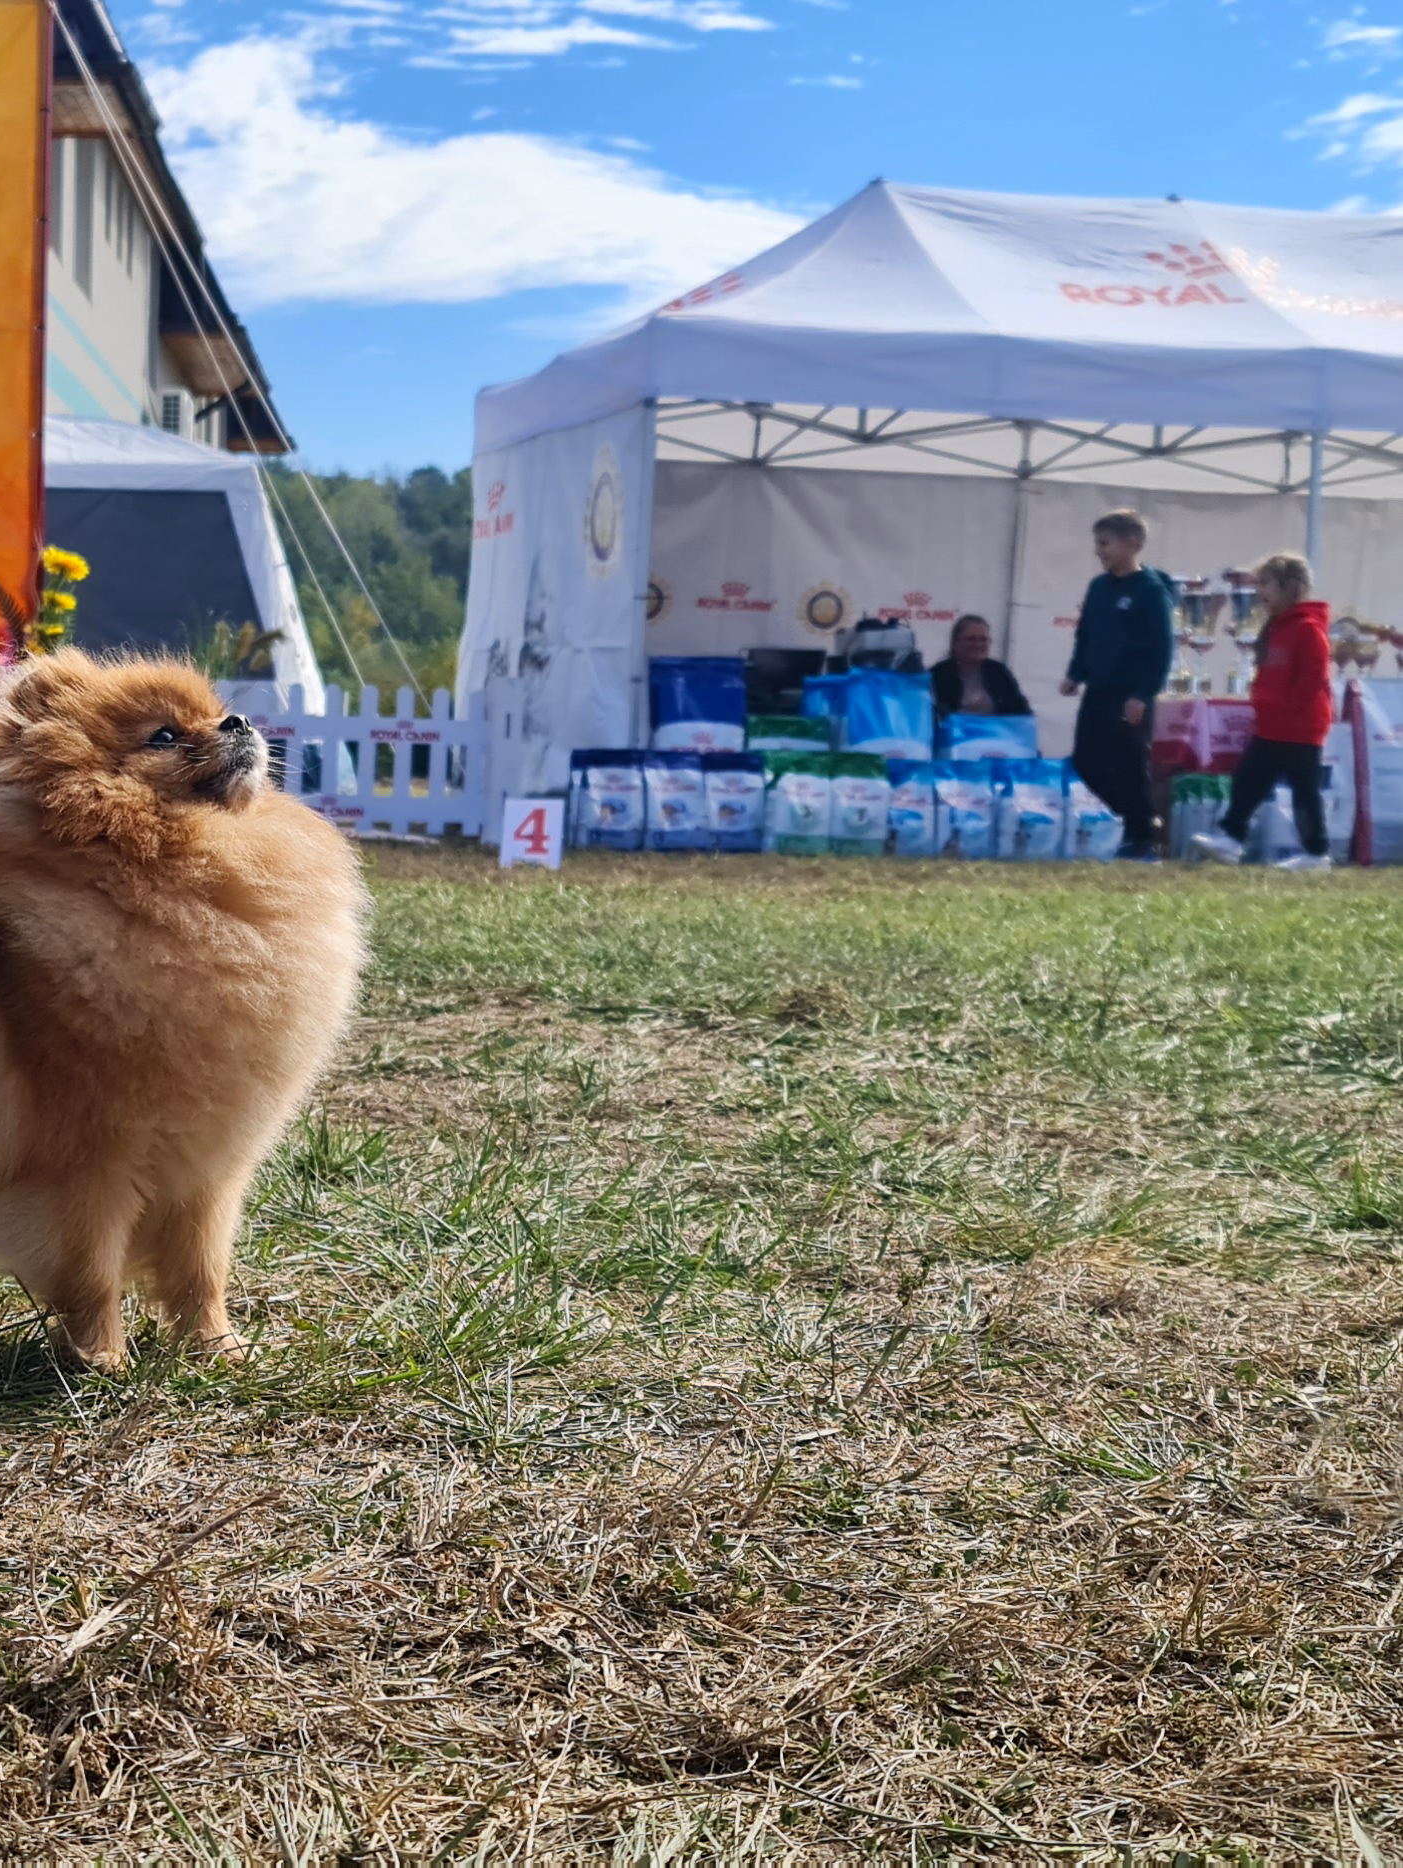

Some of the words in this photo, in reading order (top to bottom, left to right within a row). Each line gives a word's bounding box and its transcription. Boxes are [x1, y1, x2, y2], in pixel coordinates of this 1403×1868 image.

[1059, 282, 1249, 307] ROYAL
[370, 730, 404, 741] ROYAL
[406, 731, 440, 742] CANIN
[513, 807, 550, 855] 4
